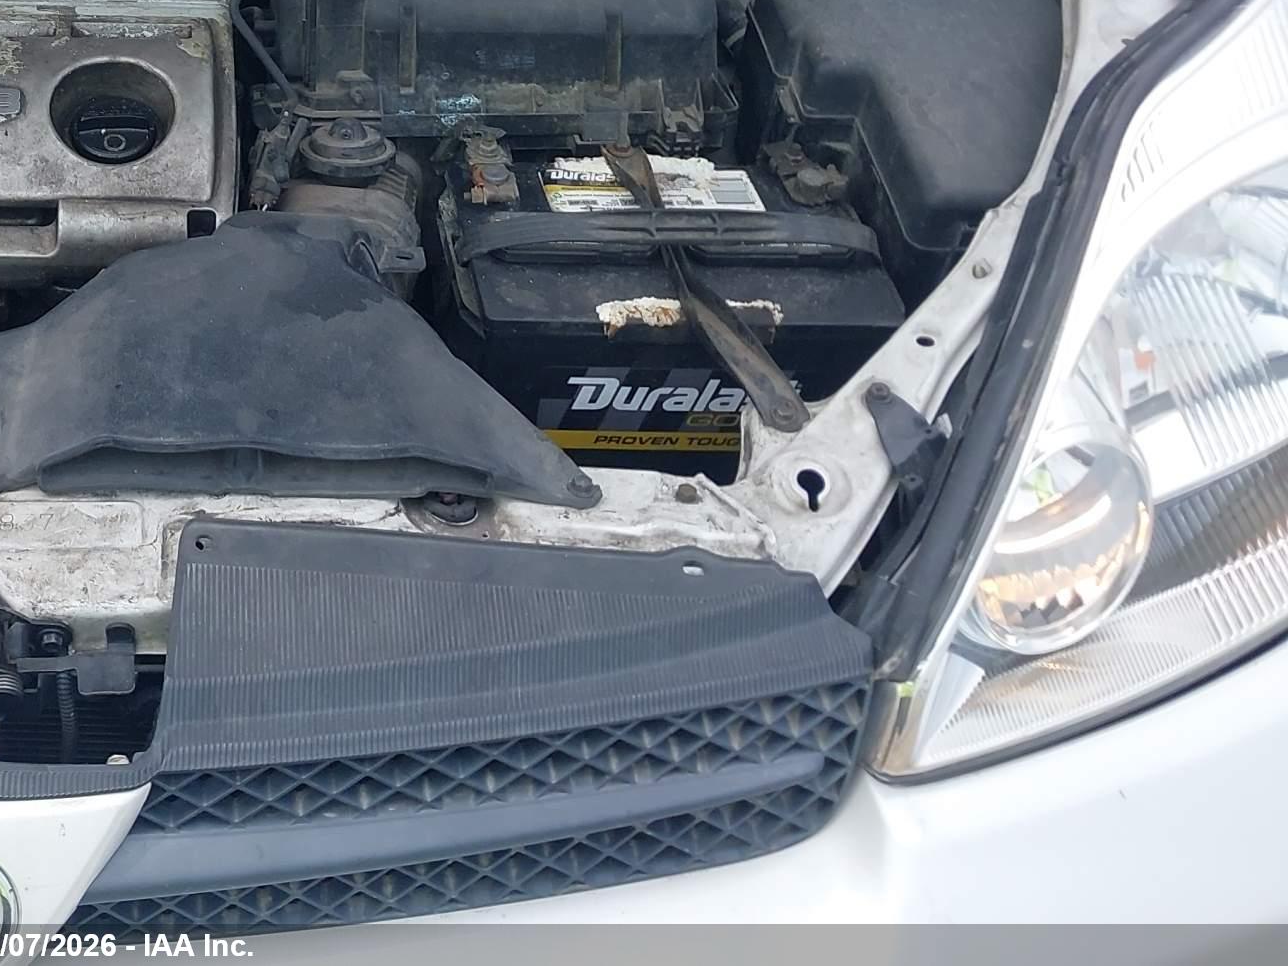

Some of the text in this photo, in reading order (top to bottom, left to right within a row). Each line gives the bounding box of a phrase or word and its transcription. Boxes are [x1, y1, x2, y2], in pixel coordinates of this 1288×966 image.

[548, 168, 617, 183] Duralas
[567, 376, 801, 412] Durala
[685, 413, 740, 427] GO
[593, 435, 741, 447] PROVEN TOUG
